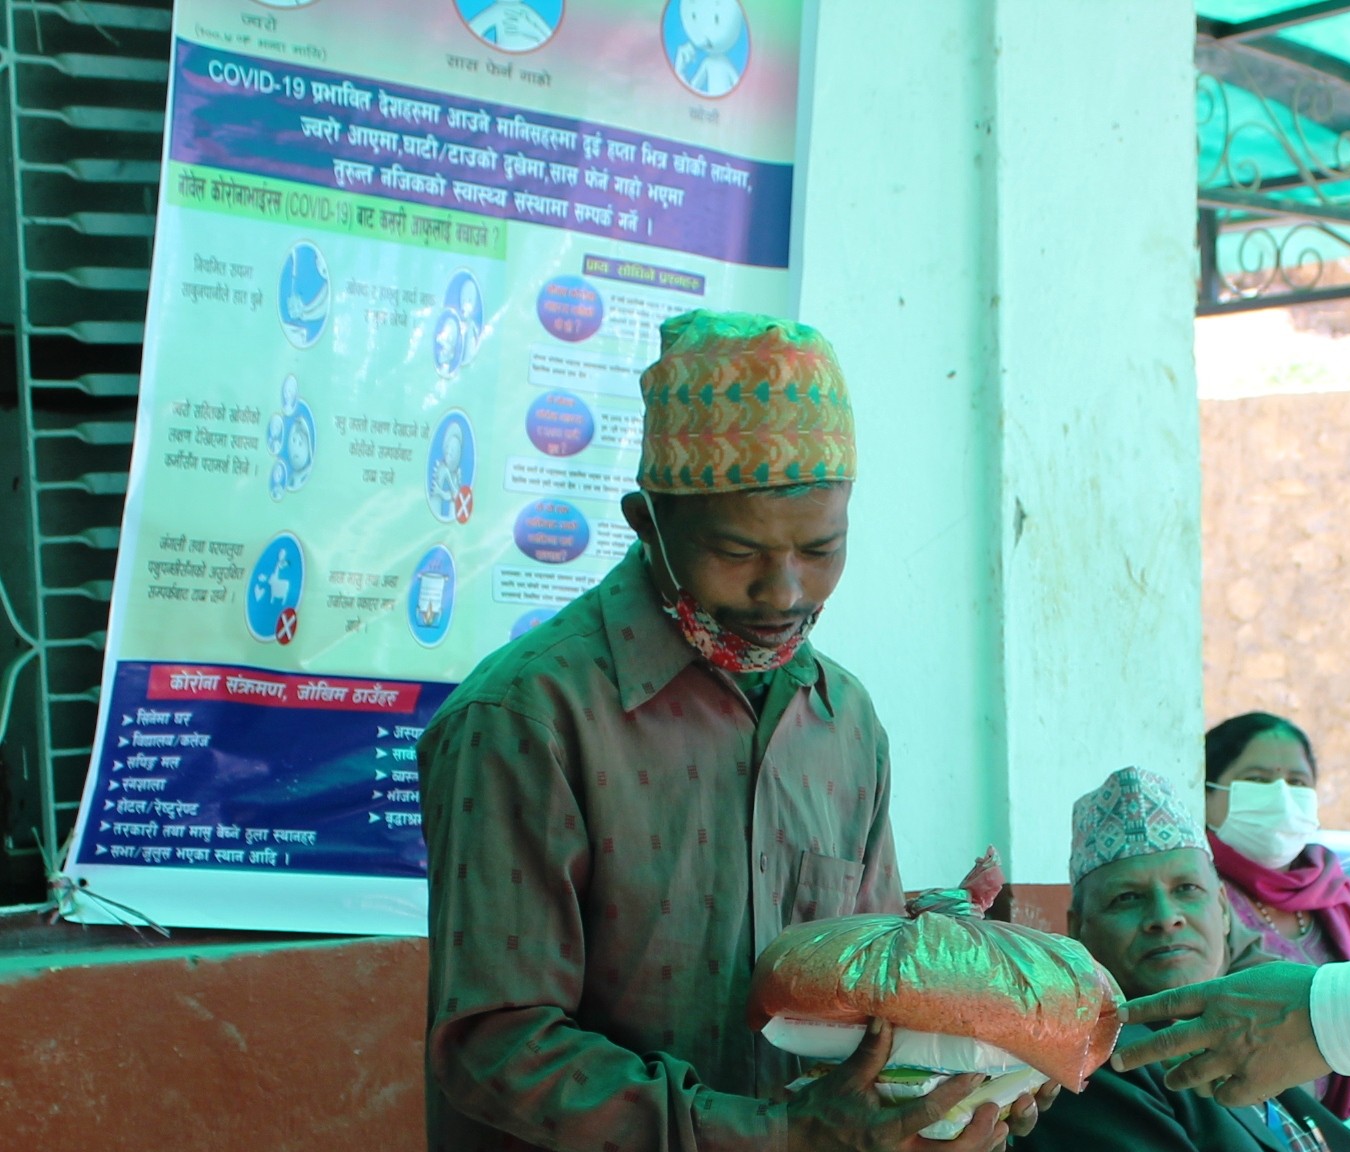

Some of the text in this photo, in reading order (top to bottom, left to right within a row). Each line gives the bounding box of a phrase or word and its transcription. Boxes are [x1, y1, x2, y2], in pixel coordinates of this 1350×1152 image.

[446, 53, 479, 73] सास
[208, 60, 305, 100] COVID-19
[311, 80, 372, 111] प्रभावित
[447, 107, 490, 134] आउने
[582, 131, 603, 159] दुई
[607, 139, 637, 163] हप्ता
[642, 141, 668, 169] भित्र
[300, 115, 342, 144] ज्वरो
[648, 183, 685, 209] भएमा
[333, 159, 375, 187] तुरुन्त
[380, 163, 447, 197] नजिकको
[452, 181, 508, 207] स्वास्थ्य
[513, 190, 569, 217] संस्थामा
[574, 202, 613, 228] सम्पर्क
[356, 206, 375, 229] बाट
[169, 669, 221, 694] कोरोना
[226, 673, 287, 702] संक्रमण,
[297, 680, 349, 702] जोखिम
[136, 707, 193, 727] सिनेमा घर
[113, 820, 159, 839] तरकारी
[162, 825, 187, 839] तथा
[188, 825, 213, 843] मासु
[175, 847, 210, 864] भएका
[214, 849, 245, 864] स्थान
[249, 847, 278, 867] आदि
